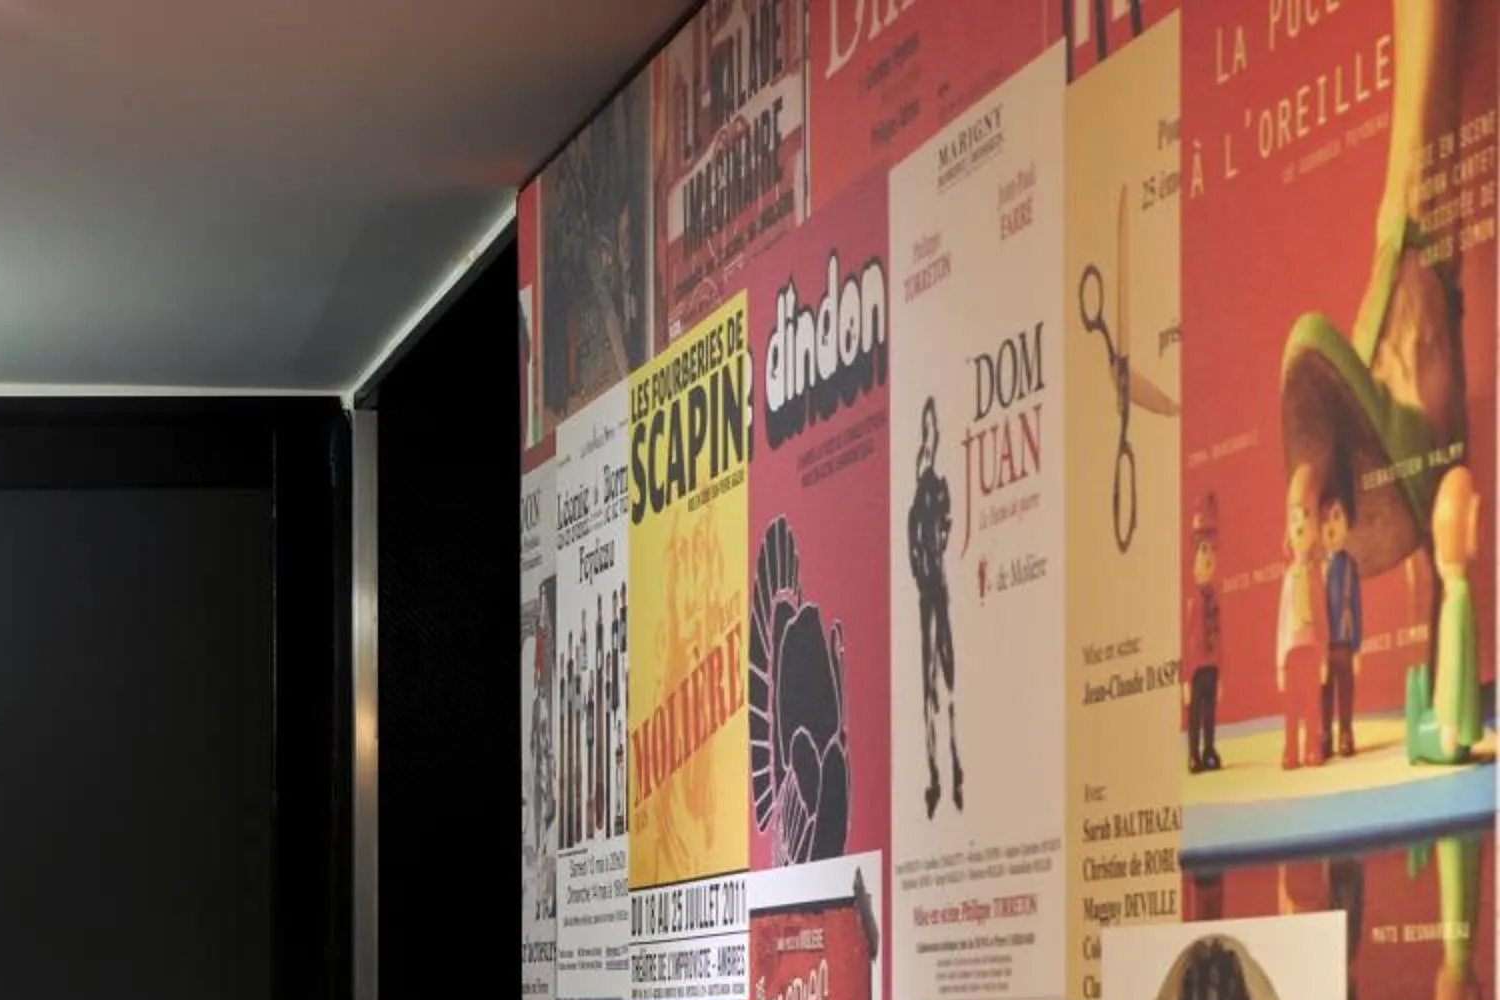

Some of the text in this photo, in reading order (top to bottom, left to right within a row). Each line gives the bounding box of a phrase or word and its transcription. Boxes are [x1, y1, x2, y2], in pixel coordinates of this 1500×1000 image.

[1216, 26, 1248, 84] LA
[683, 95, 784, 258] IMAGINAIRE
[937, 103, 1003, 164] MARIGNY
[1190, 140, 1205, 198] À
[631, 310, 744, 424] LES FOURBERIES DE
[765, 248, 887, 418] dindon
[973, 321, 1044, 422] DOM
[631, 355, 745, 524] SCAPIN
[961, 403, 1043, 558] JUAN
[631, 633, 745, 808] MOLIÈRE
[631, 894, 642, 936] DU
[658, 890, 668, 933] AU
[672, 888, 682, 931] 25
[684, 881, 719, 930] JUILLET
[722, 876, 745, 926] 2011
[1124, 884, 1176, 921] DEVILLE
